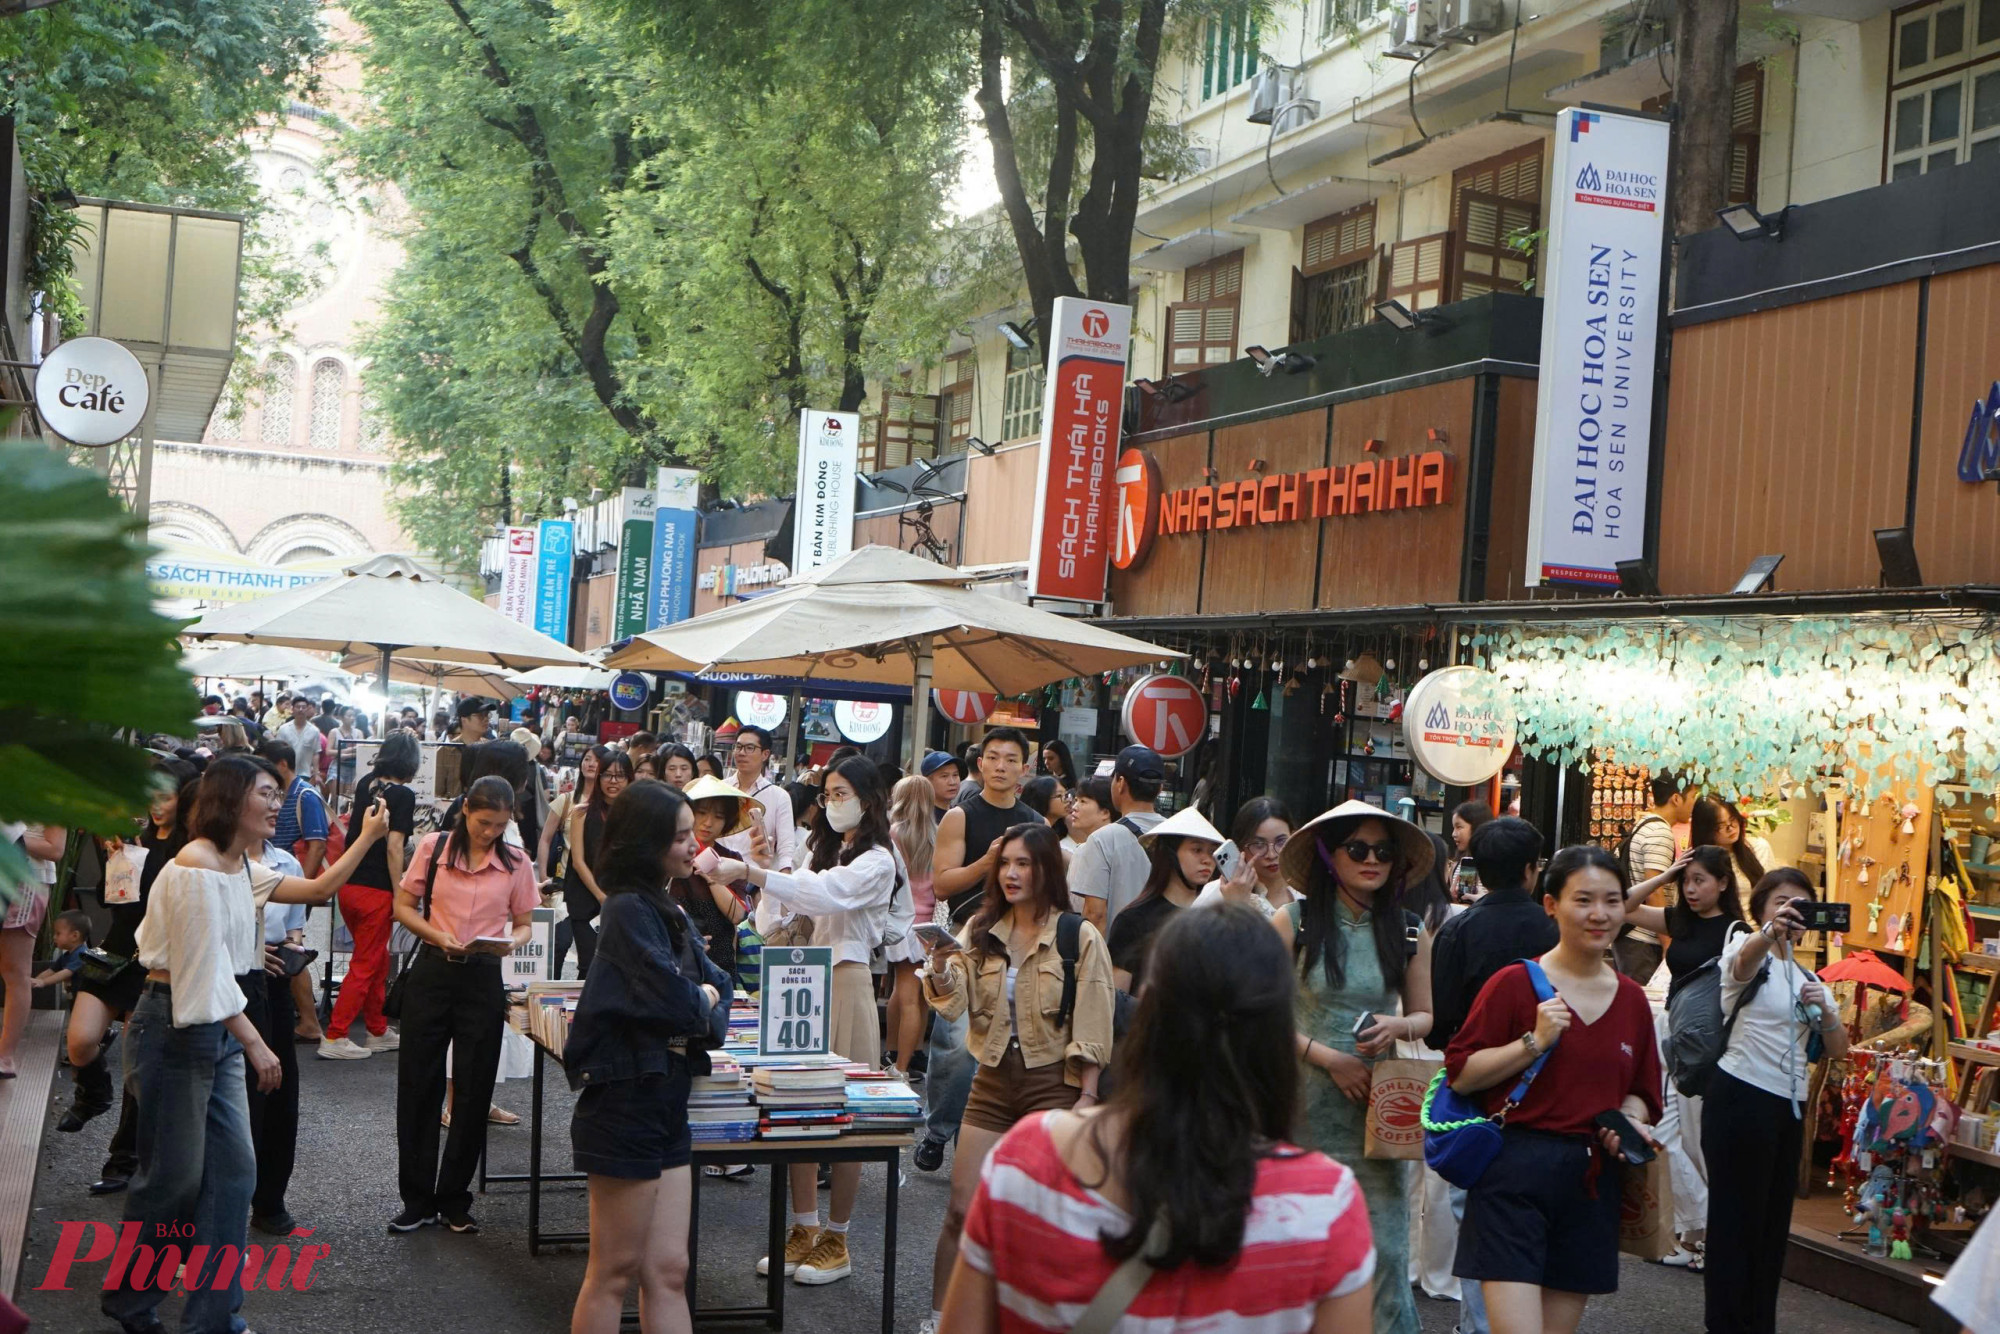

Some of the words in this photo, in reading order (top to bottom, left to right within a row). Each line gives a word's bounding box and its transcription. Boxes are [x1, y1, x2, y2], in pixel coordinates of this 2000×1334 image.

[1605, 183, 1631, 196] HOA
[1633, 186, 1657, 199] SEN
[1587, 244, 1612, 307] SEN
[1612, 250, 1638, 408] UNIVERSITY
[1582, 314, 1608, 386] HOA
[65, 367, 106, 391] Đẹp
[1071, 373, 1093, 416] HÀ
[59, 384, 125, 414] Café
[1577, 393, 1603, 470] HỌC
[1066, 424, 1088, 489] THÁI
[1609, 423, 1627, 473] SEN
[831, 461, 842, 498] HOUSE
[1083, 399, 1110, 558] THAIHABOOKS
[1215, 459, 1301, 529] SÁCH
[815, 504, 825, 527] KIM
[1572, 476, 1599, 536] ĐẠI
[1604, 486, 1623, 538] HOA
[663, 522, 675, 549] NAM
[677, 533, 686, 559] BOOK
[810, 531, 823, 557] BẢN
[826, 501, 840, 563] PUBLISHING
[1057, 498, 1082, 578] SÁCH
[158, 564, 210, 584] SÁCH
[216, 569, 283, 590] THÀNH
[519, 559, 528, 578] MINH
[632, 557, 648, 588] NAM
[675, 562, 684, 583] NAM
[1550, 568, 1582, 577] RESPECT
[1585, 572, 1620, 581] DIVERSIT
[628, 592, 644, 621] NHÃ
[514, 961, 536, 975] NHI
[1375, 1127, 1424, 1141] COFFE
